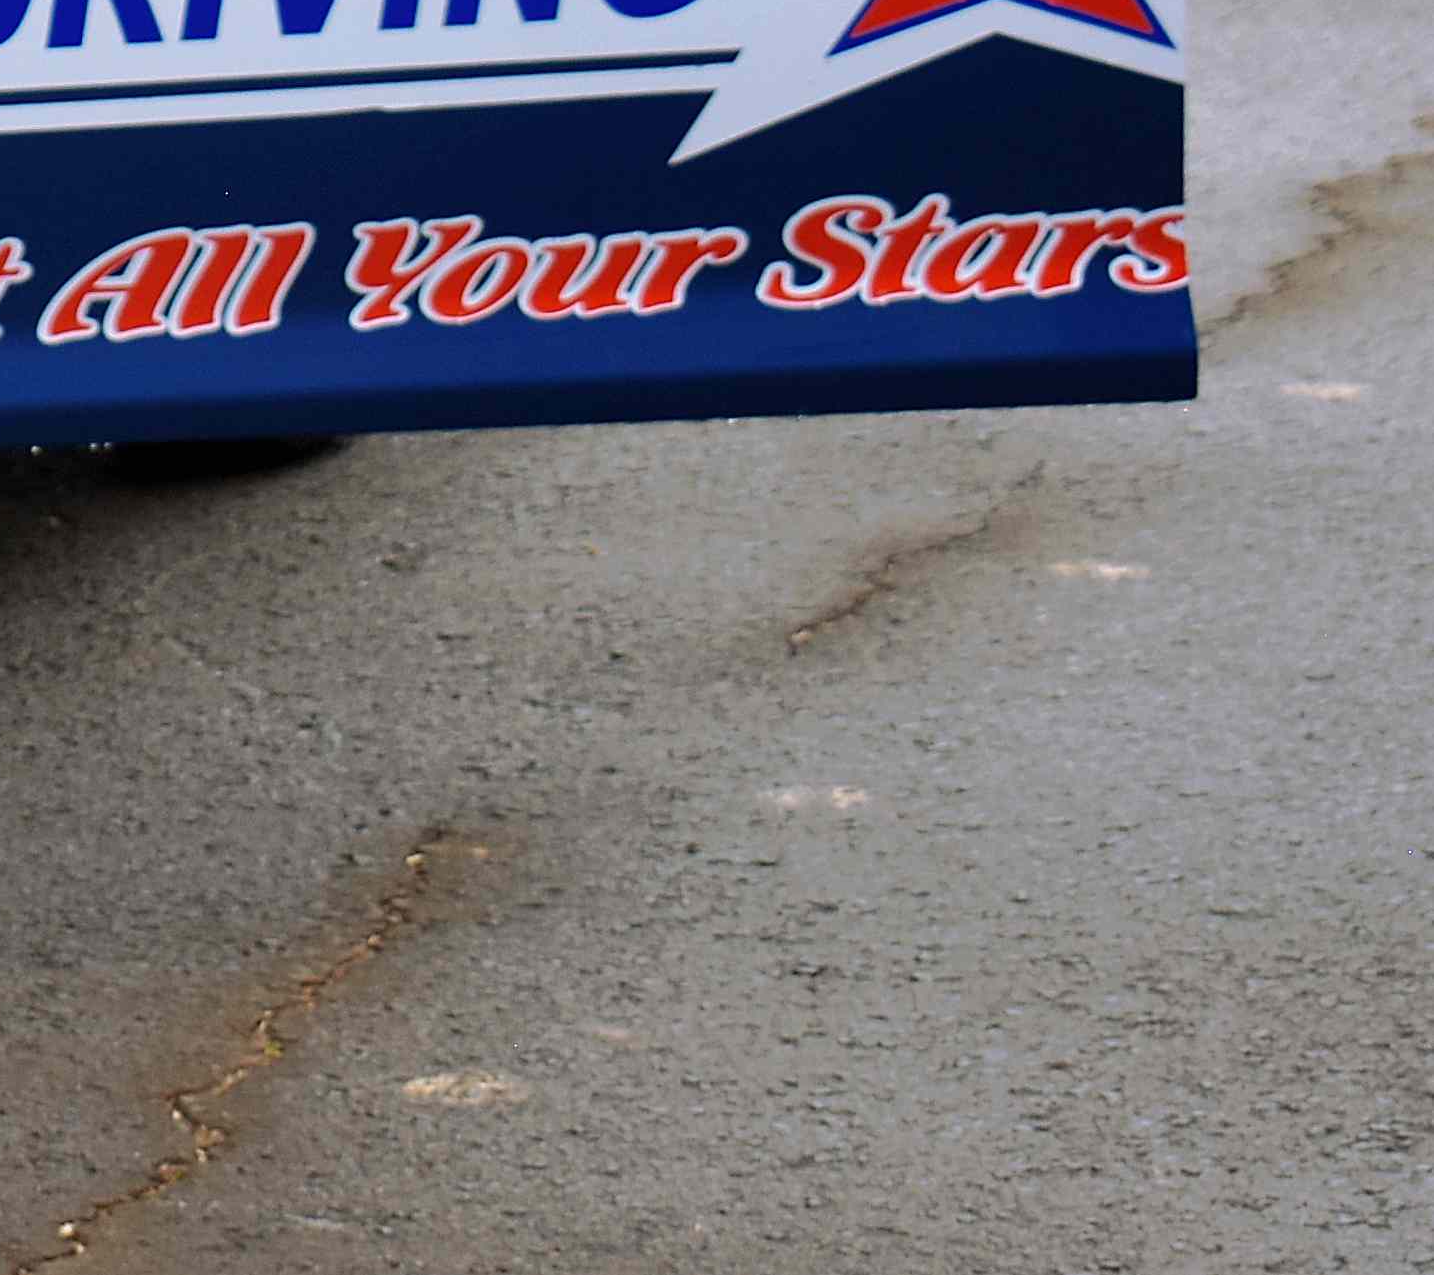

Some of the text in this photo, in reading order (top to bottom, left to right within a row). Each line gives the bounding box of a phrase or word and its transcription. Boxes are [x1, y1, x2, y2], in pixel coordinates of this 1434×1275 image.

[36, 221, 316, 346] All
[348, 214, 747, 332] Your
[755, 192, 1190, 310] Stars
